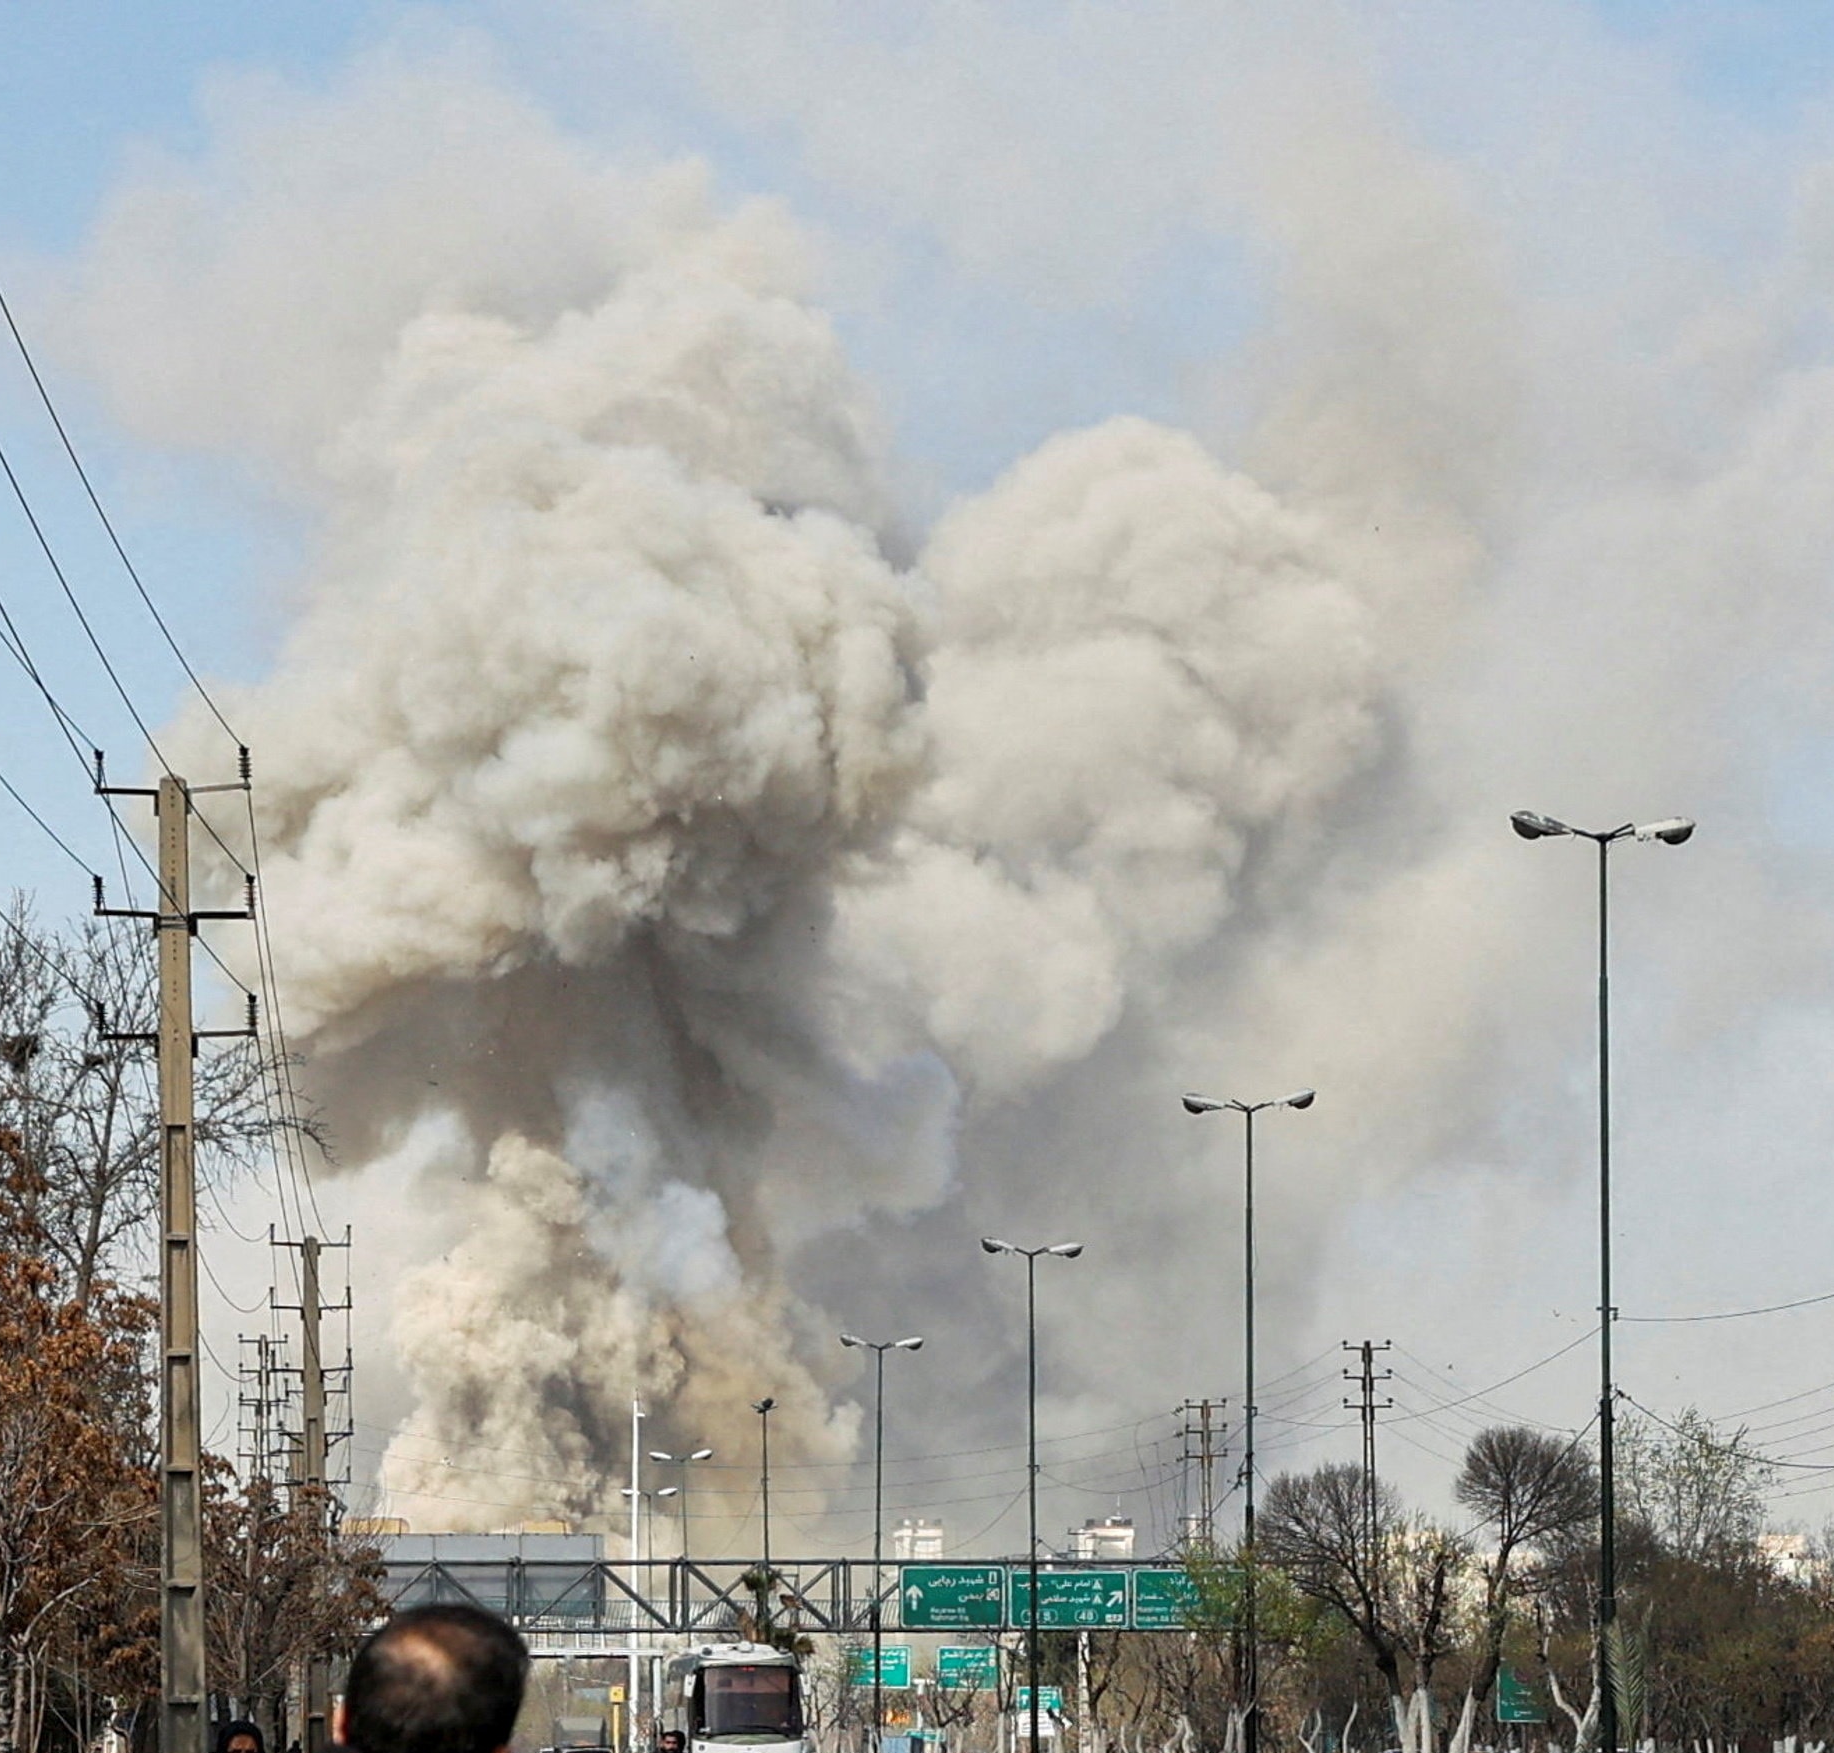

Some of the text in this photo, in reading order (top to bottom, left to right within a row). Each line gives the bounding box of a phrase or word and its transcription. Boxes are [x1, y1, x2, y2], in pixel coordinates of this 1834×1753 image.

[928, 1574, 985, 1588] شهید رجایی
[1074, 1580, 1091, 1591] امام
[1068, 1593, 1091, 1604] شهید
